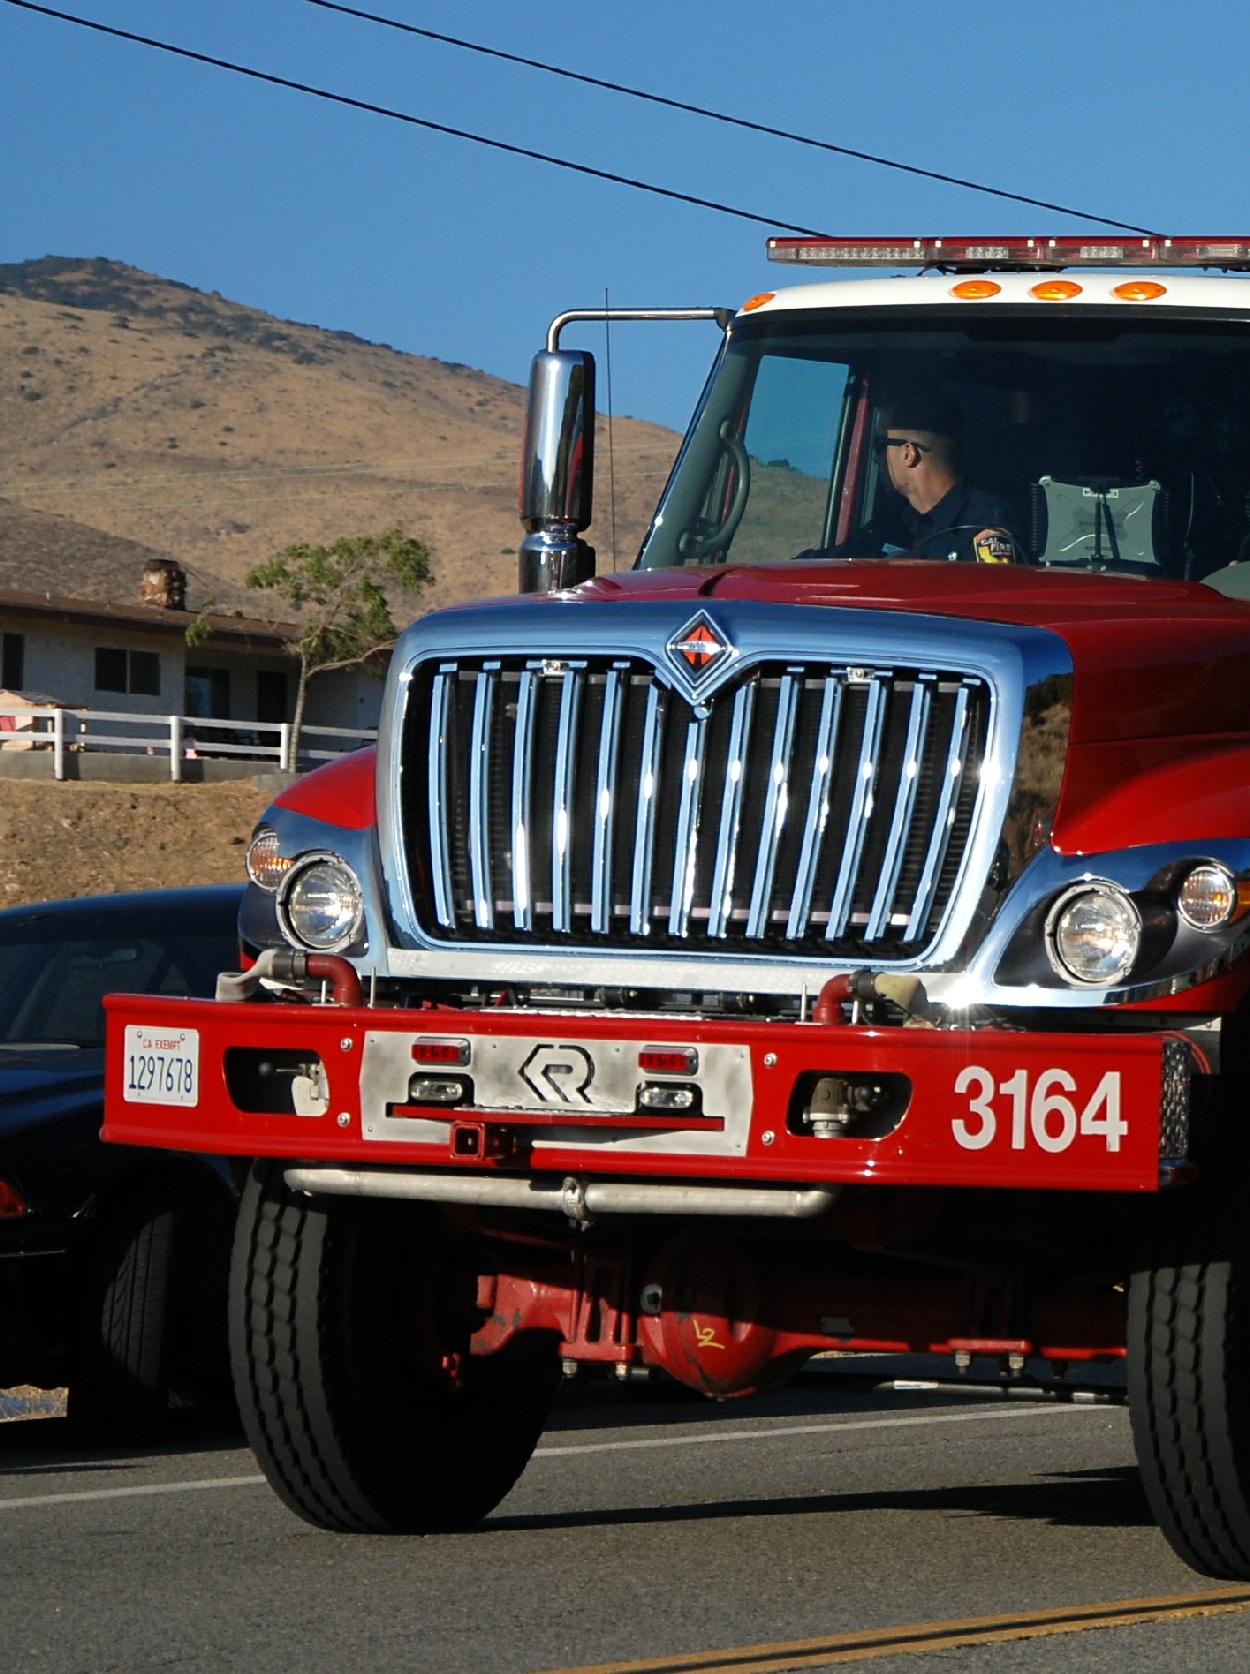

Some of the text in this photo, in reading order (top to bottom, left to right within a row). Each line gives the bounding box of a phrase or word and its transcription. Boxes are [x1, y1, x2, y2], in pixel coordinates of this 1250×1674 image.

[143, 1039, 181, 1050] CA EXEMPT
[129, 1055, 193, 1094] 1297678
[951, 1065, 1128, 1153] 3164
